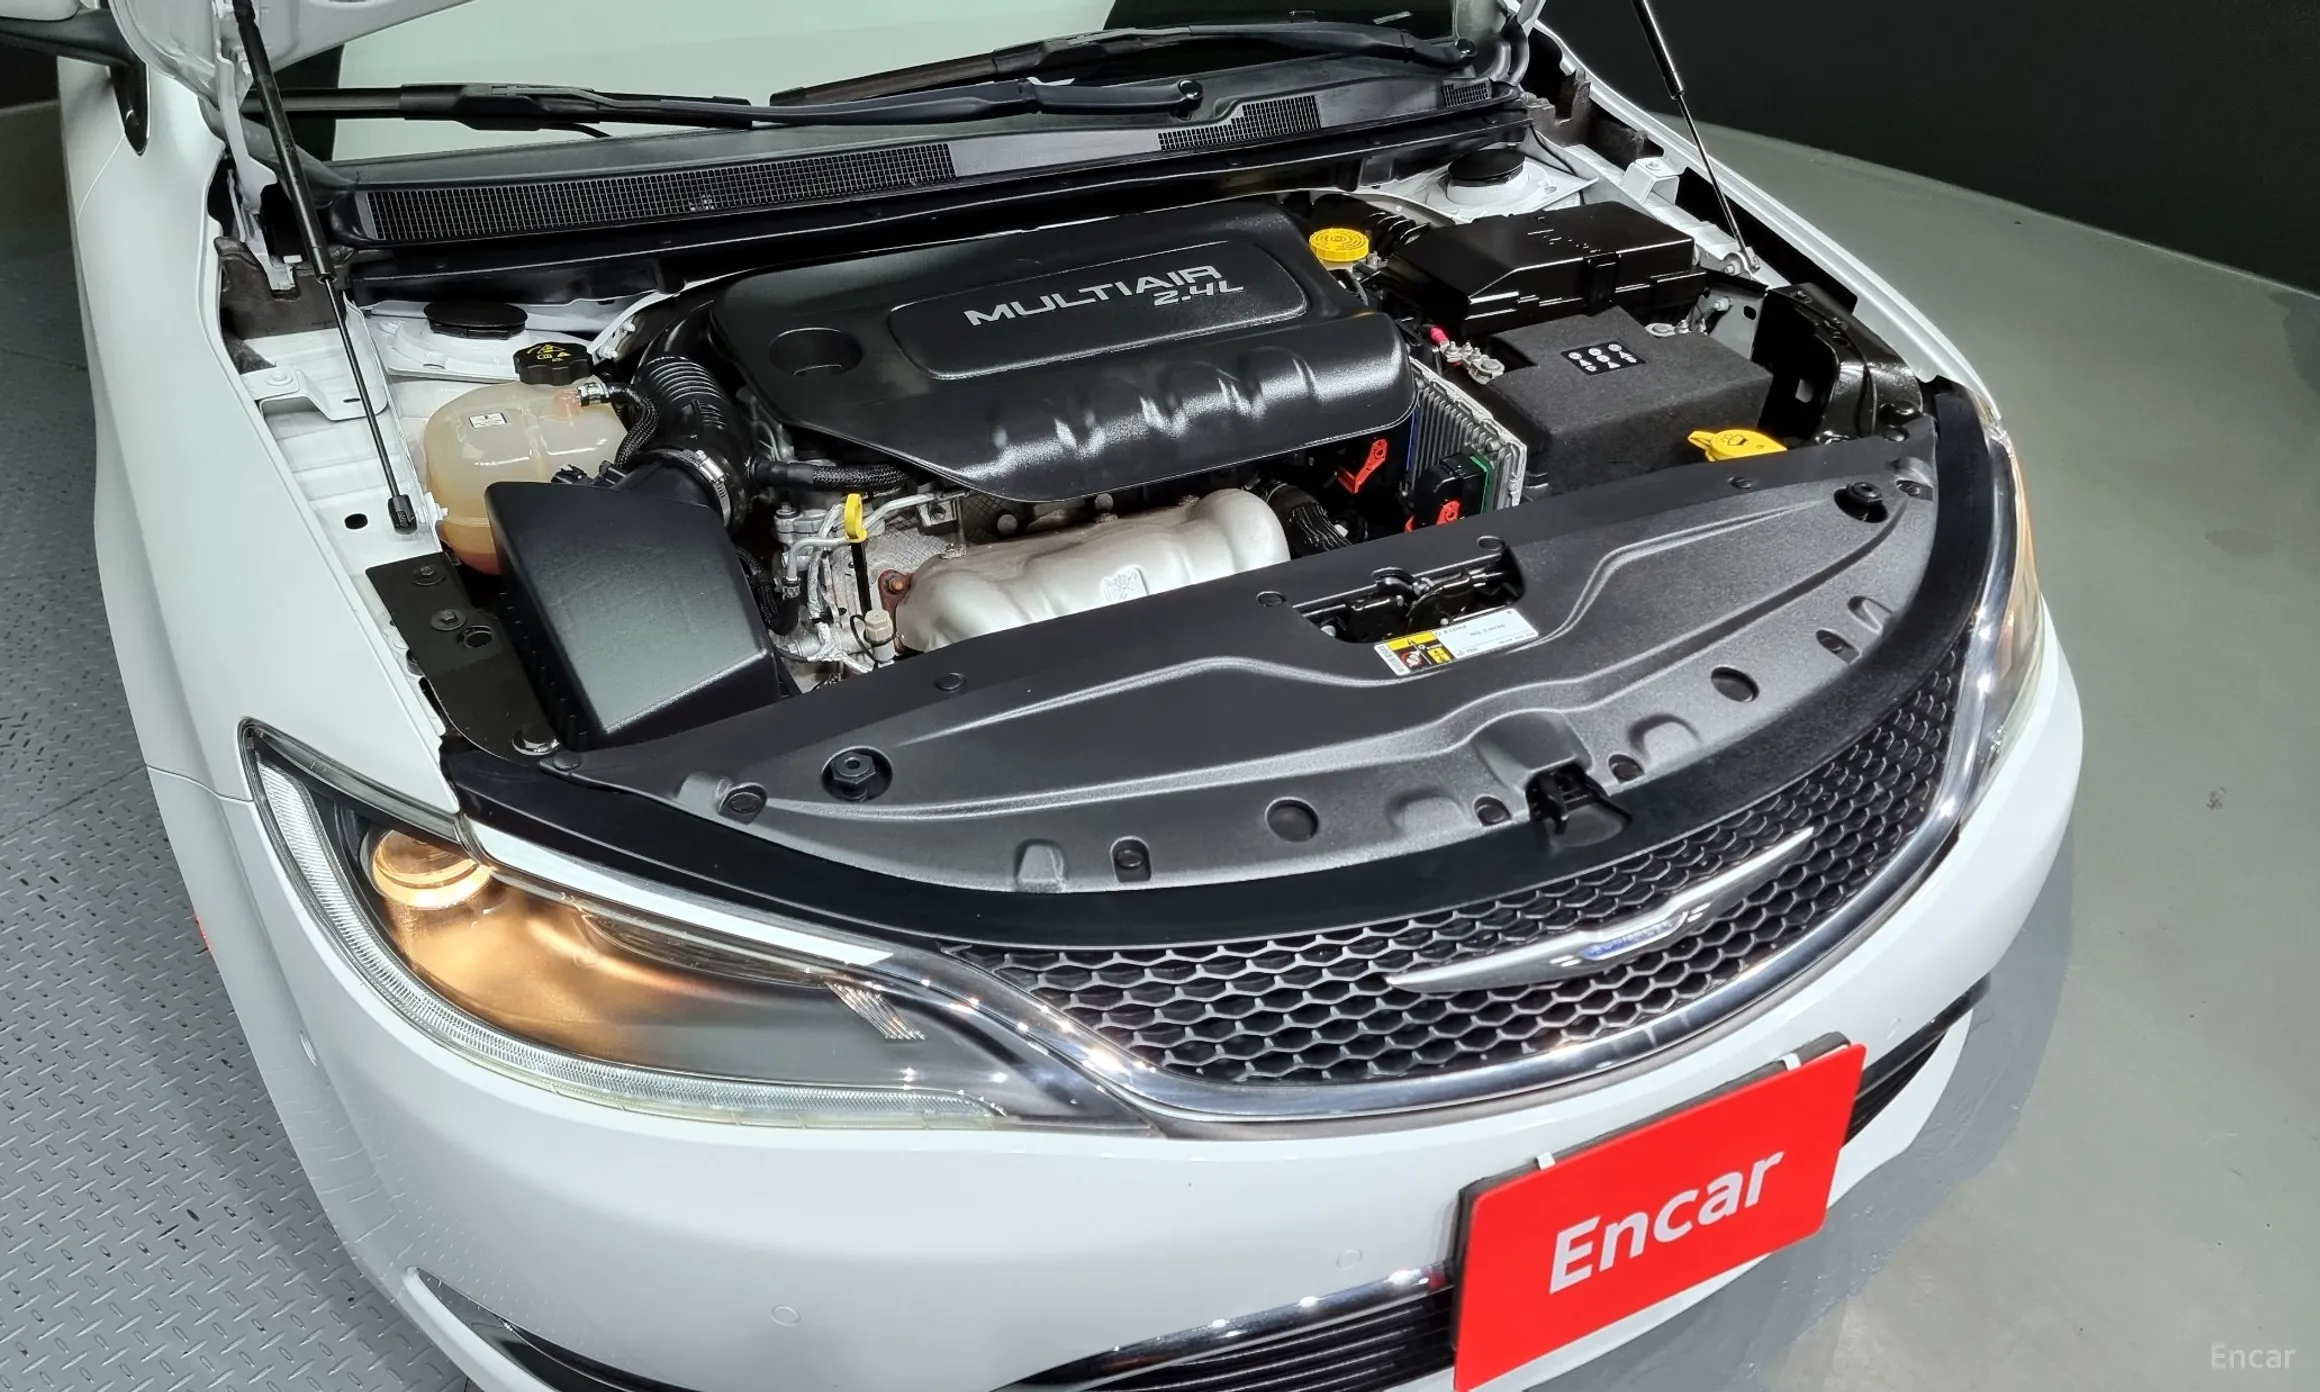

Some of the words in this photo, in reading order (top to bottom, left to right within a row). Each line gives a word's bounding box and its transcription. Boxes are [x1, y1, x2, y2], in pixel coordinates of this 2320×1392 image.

[963, 265, 1223, 327] MULTIAIR
[1153, 280, 1245, 307] 2.4L
[1548, 1151, 1785, 1295] Encar
